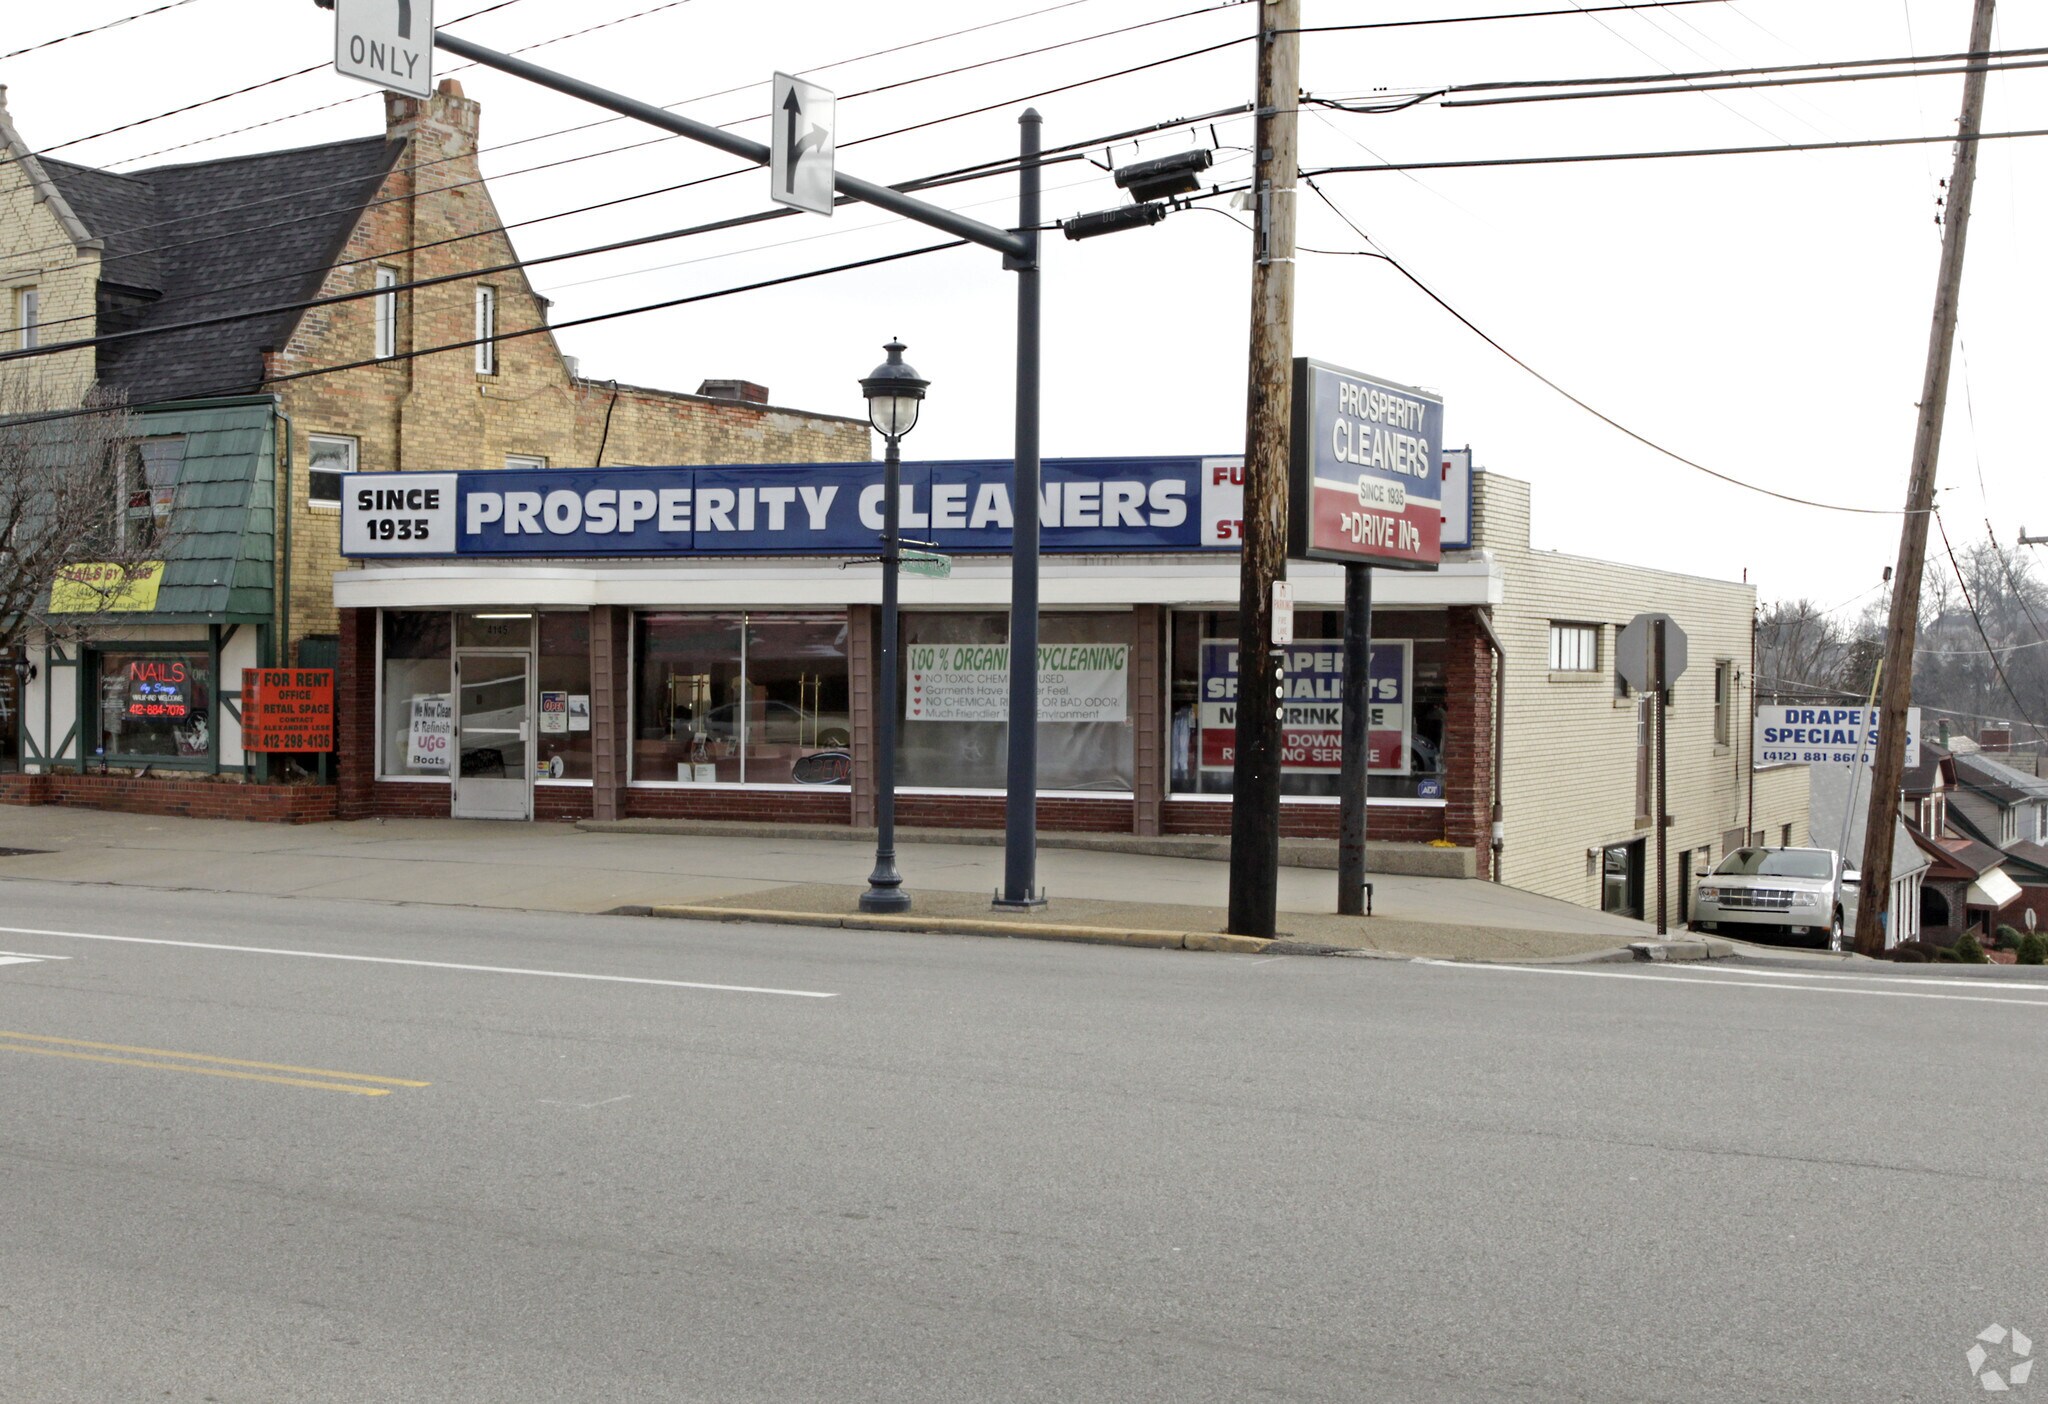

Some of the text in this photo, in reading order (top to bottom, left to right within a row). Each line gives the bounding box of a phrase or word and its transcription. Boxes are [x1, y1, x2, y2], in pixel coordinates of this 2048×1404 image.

[350, 35, 419, 79] ONLY
[1339, 381, 1426, 433] PROSPERITY
[1332, 418, 1429, 479] CLEANERS
[358, 488, 440, 511] SINCE
[1360, 482, 1404, 506] SINCE 1935
[466, 479, 1188, 535] PROSPERITY CLEANERS
[366, 518, 430, 541] 1935
[1351, 512, 1411, 550] DRIVE IN
[911, 647, 1124, 671] 100 % ORGANI RYCLEANING
[130, 662, 186, 682] NAILS
[926, 674, 942, 683] NO
[945, 674, 973, 684] TOXIC
[264, 673, 329, 687] FOR RENT
[925, 686, 974, 696] Garments
[977, 686, 1003, 695] Have
[1047, 686, 1071, 696] Feel.
[129, 703, 185, 716] 412-884-7075
[264, 704, 330, 714] RETAIL SPACE
[925, 697, 941, 707] NO
[944, 697, 998, 707] CHEMICAL
[1042, 698, 1058, 708] OR
[1061, 698, 1081, 708] BAD
[424, 703, 436, 717] Now
[437, 703, 451, 718] Clean
[925, 708, 953, 718] Much
[956, 708, 1000, 718] Friendlier
[1037, 710, 1099, 719] Environment
[414, 721, 450, 733] & Refinish
[264, 734, 330, 748] 412-298-4136
[418, 735, 446, 752] UGG
[1288, 734, 1342, 748] DOWN
[413, 755, 446, 765] Boots
[1763, 751, 1797, 761] (412)
[1421, 786, 1437, 795] ADT
